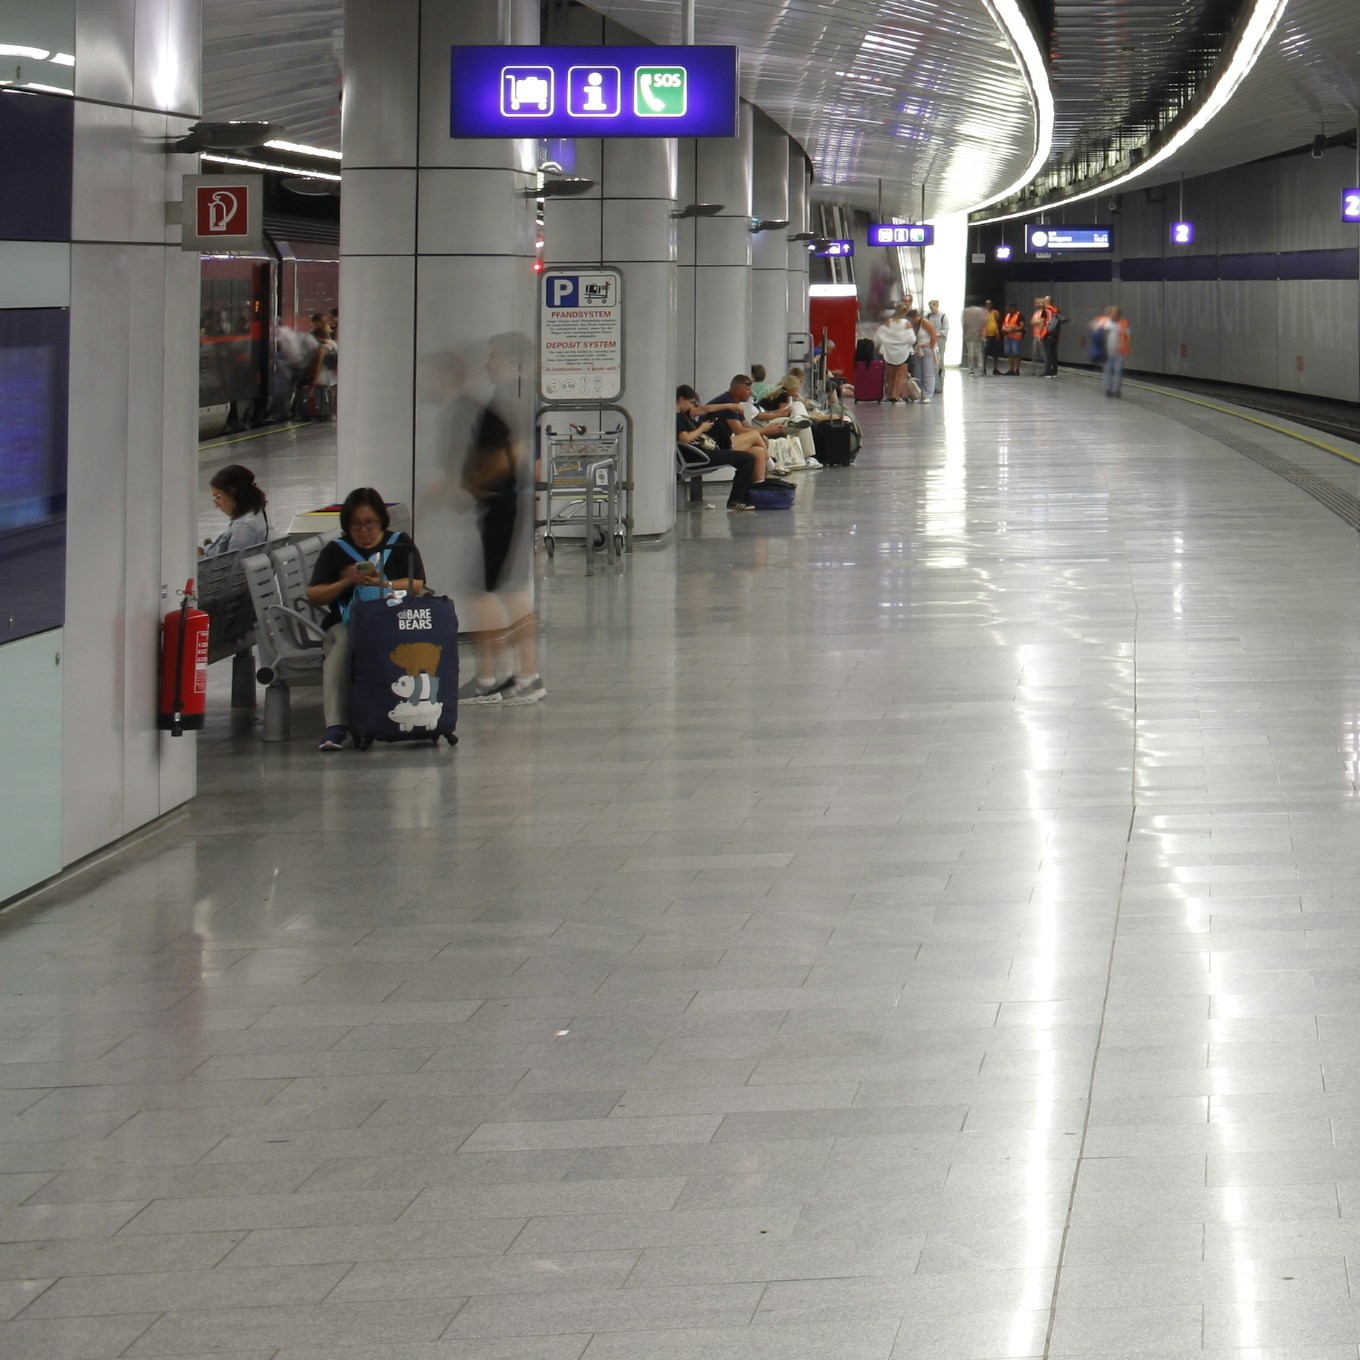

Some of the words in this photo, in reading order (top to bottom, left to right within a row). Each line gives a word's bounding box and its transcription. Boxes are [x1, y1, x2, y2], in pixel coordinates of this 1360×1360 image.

[653, 73, 681, 87] SOS
[1176, 224, 1189, 242] 2
[553, 279, 574, 306] P
[407, 608, 432, 620] BARE
[399, 619, 432, 630] BEARS
